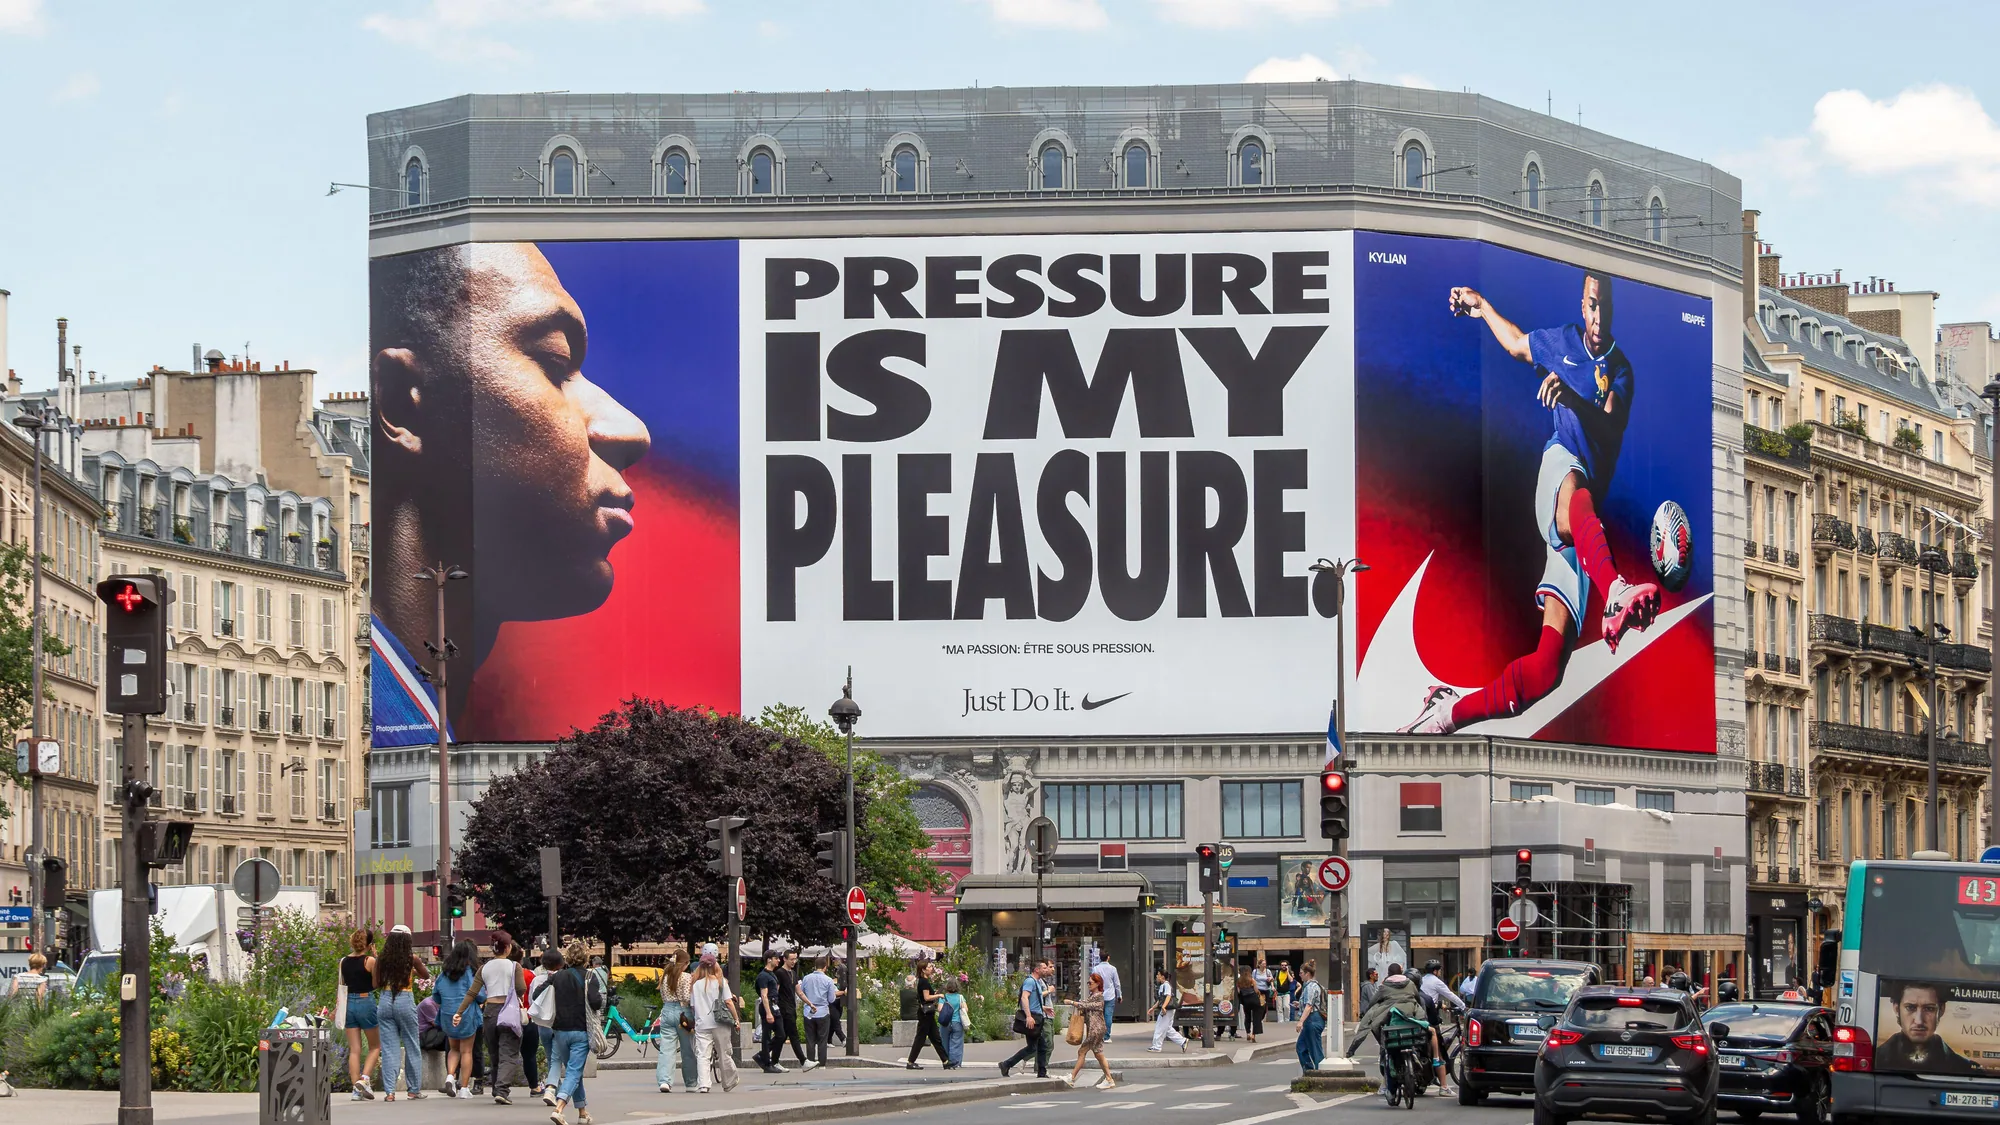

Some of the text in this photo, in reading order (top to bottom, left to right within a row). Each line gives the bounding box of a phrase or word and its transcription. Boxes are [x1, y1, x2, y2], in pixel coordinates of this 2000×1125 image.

[1369, 251, 1407, 265] KYLIAN
[766, 251, 1330, 321] PRESSURE
[1681, 311, 1706, 327] MBAPPÉ
[766, 325, 1330, 443] IS MY
[967, 644, 1021, 655] PASSION:
[1023, 641, 1054, 654] ÊTRE
[1056, 643, 1090, 654] SOUS
[1092, 643, 1155, 654] PRESSION.
[961, 687, 1075, 718] Just Do It.
[375, 721, 433, 733] Photographie retouchée
[1965, 879, 1997, 903] 43
[1961, 988, 1971, 998] LA
[1839, 1005, 1851, 1024] 70
